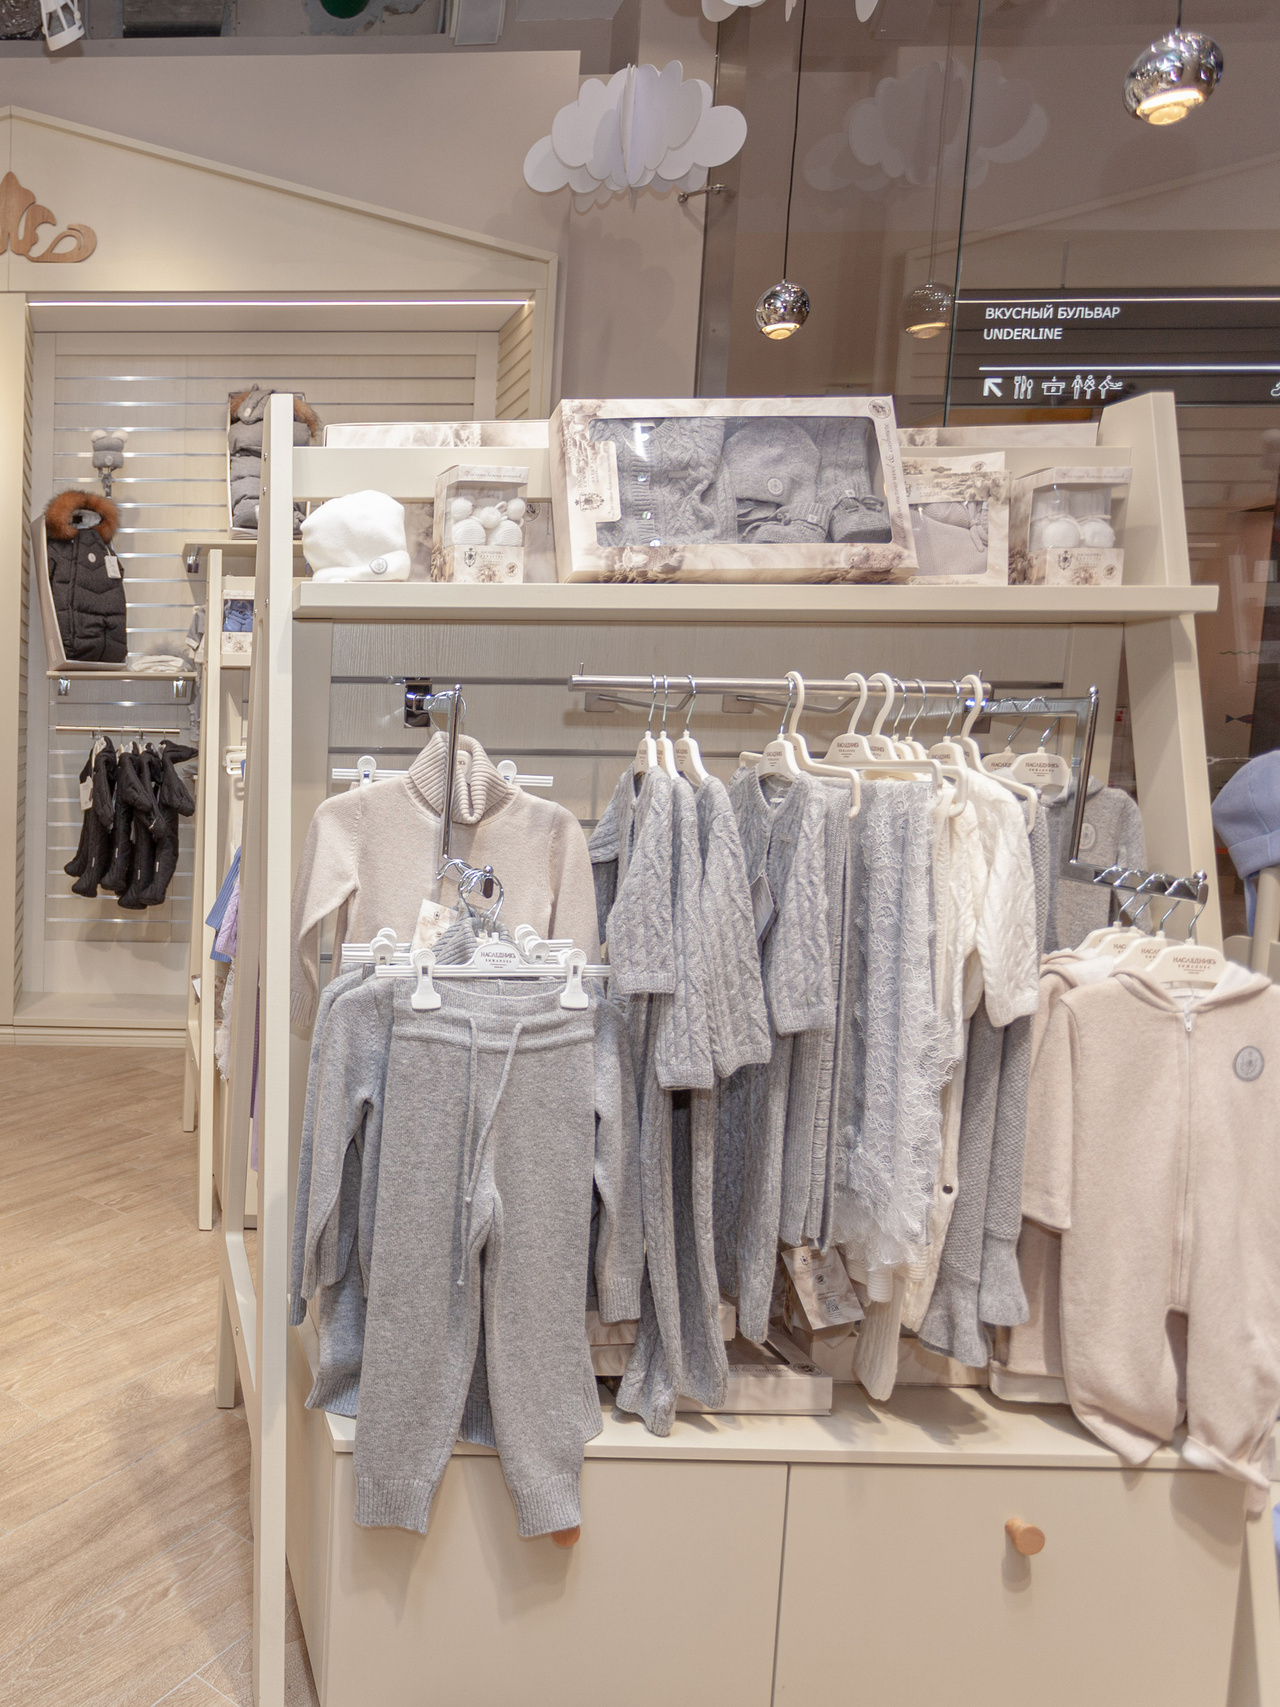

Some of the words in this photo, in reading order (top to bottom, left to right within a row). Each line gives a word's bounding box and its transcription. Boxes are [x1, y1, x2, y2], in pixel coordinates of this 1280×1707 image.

[985, 304, 1053, 320] ВКУСНЫЙ
[1057, 306, 1120, 319] БУЛЬВАР
[983, 328, 1063, 340] UNDERLINE
